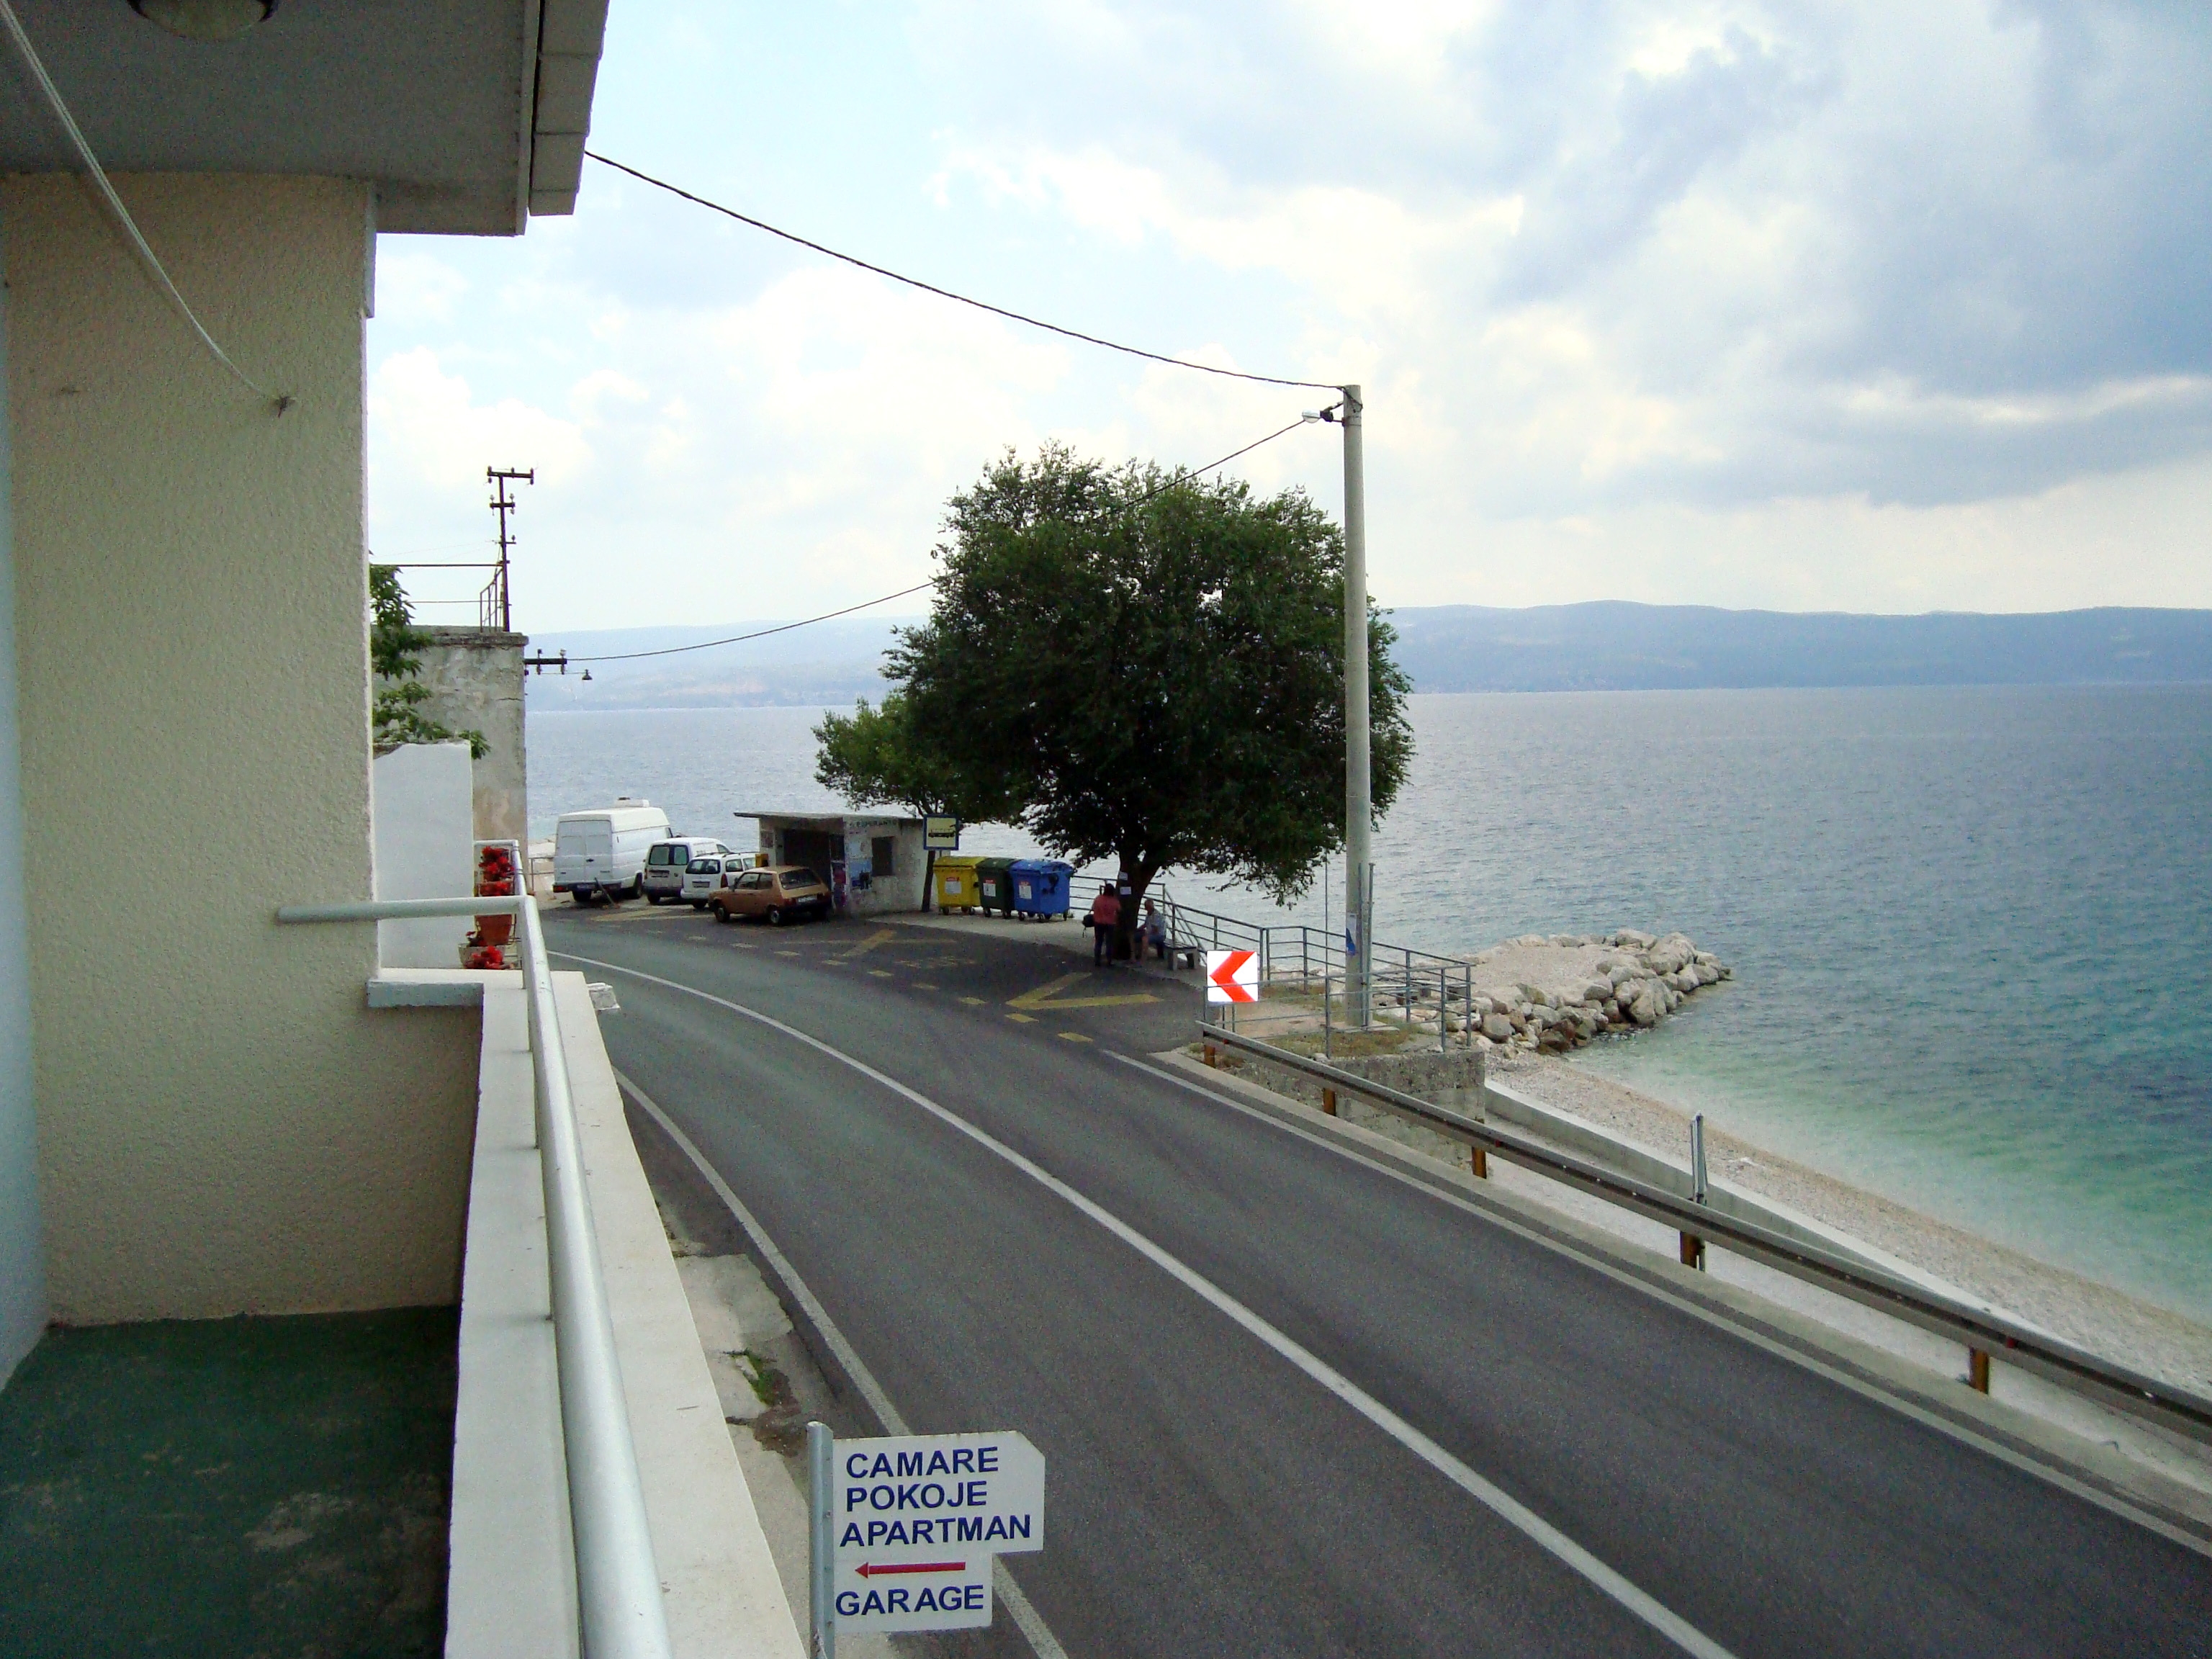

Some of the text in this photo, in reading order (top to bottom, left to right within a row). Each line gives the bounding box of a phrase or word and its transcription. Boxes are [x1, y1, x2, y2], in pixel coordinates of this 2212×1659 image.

[846, 1446, 999, 1478] CAMARE
[846, 1480, 987, 1512] POKOJE
[840, 1514, 1030, 1547] APARTMAN
[835, 1584, 984, 1616] GARAGE
